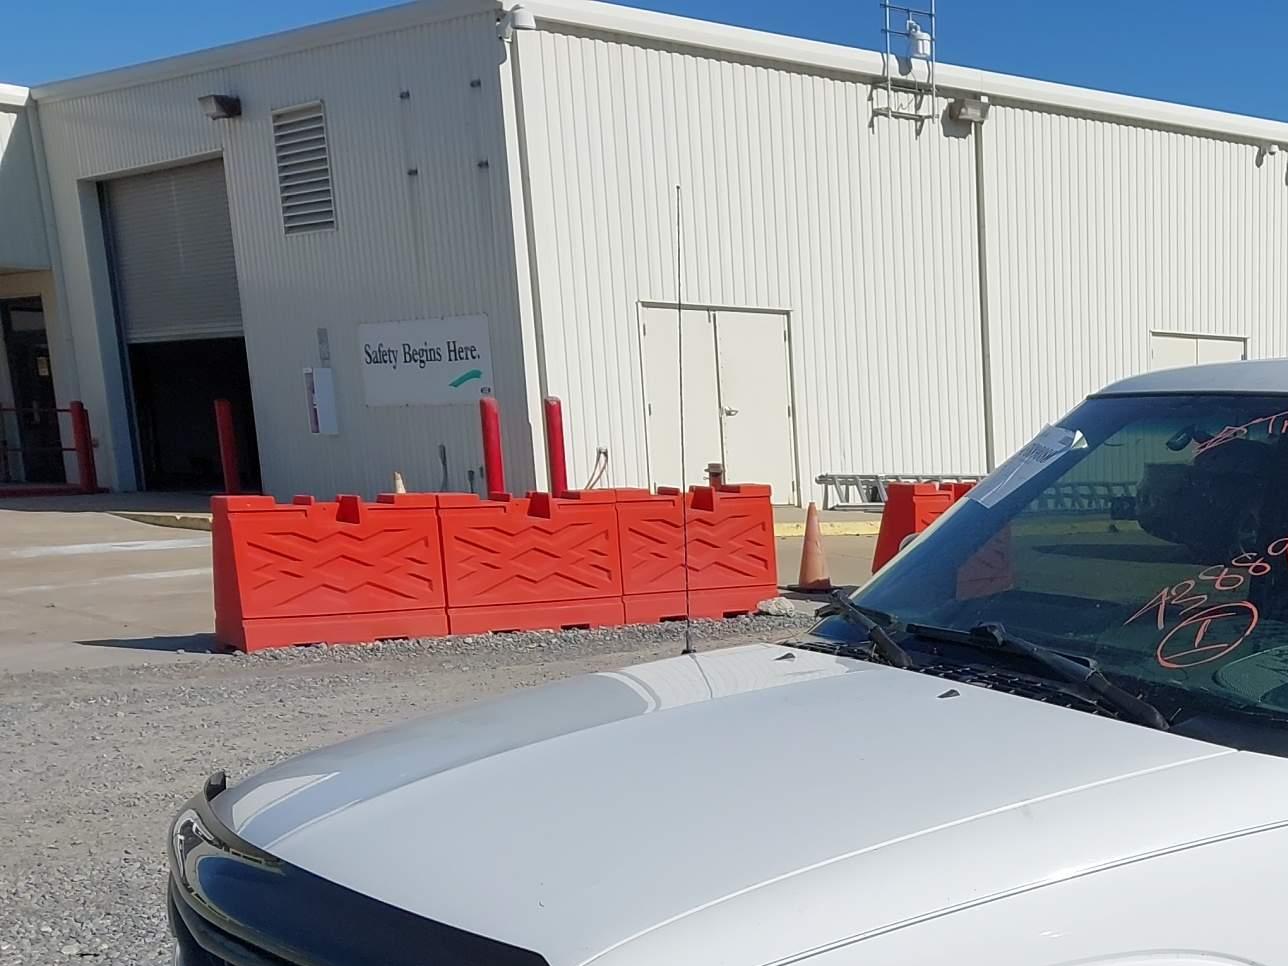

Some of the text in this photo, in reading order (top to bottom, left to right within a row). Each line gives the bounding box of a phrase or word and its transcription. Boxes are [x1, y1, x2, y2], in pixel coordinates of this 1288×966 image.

[364, 340, 481, 370] Safety Begins Here.
